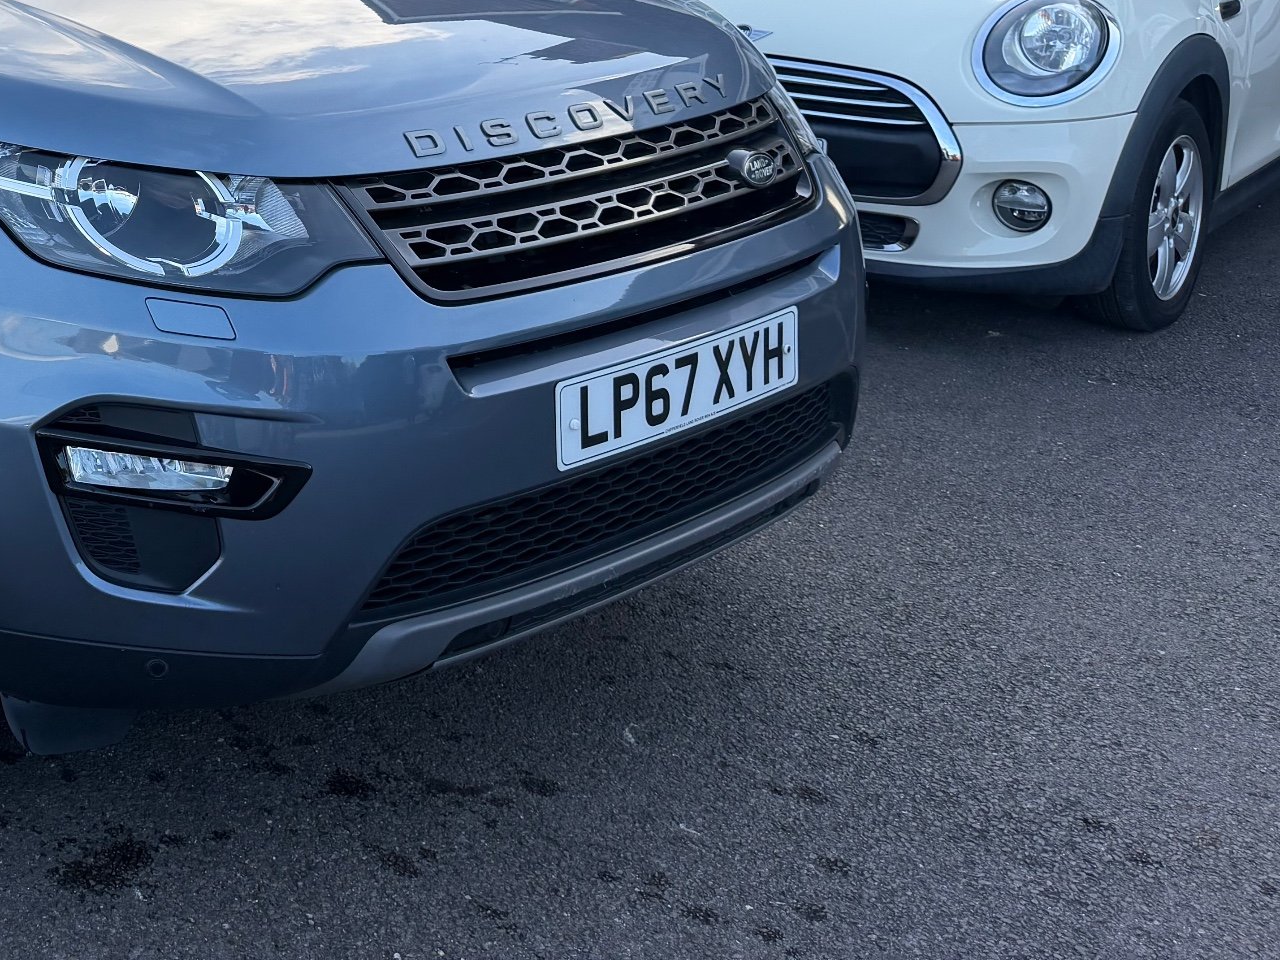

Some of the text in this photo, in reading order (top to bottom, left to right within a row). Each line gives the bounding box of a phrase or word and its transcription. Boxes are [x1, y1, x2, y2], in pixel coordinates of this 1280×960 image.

[403, 73, 729, 158] DISCOVERY
[749, 158, 767, 171] LAND
[754, 164, 773, 179] ROVER
[579, 321, 785, 450] LP67 XYH
